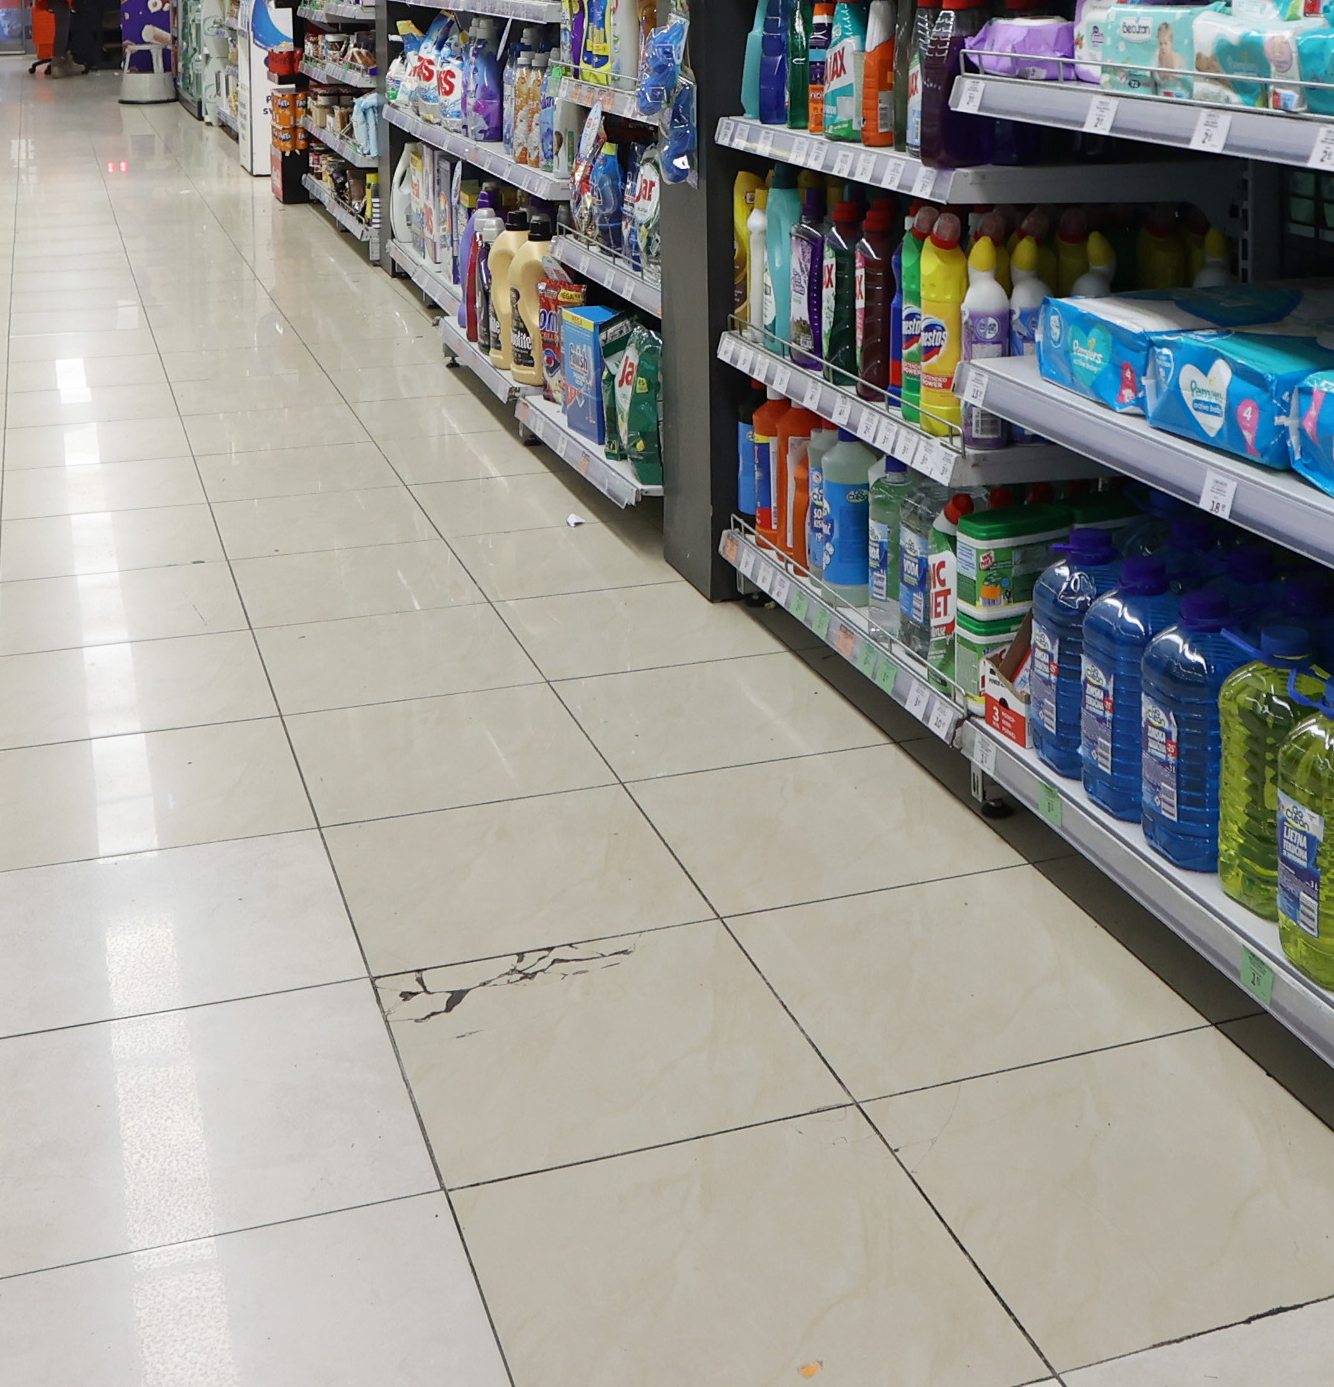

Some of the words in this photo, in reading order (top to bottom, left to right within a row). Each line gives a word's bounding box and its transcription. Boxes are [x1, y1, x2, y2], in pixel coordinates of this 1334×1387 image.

[1242, 406, 1253, 422] 4
[992, 705, 1001, 723] 3
[1283, 826, 1308, 849] LJETNA
